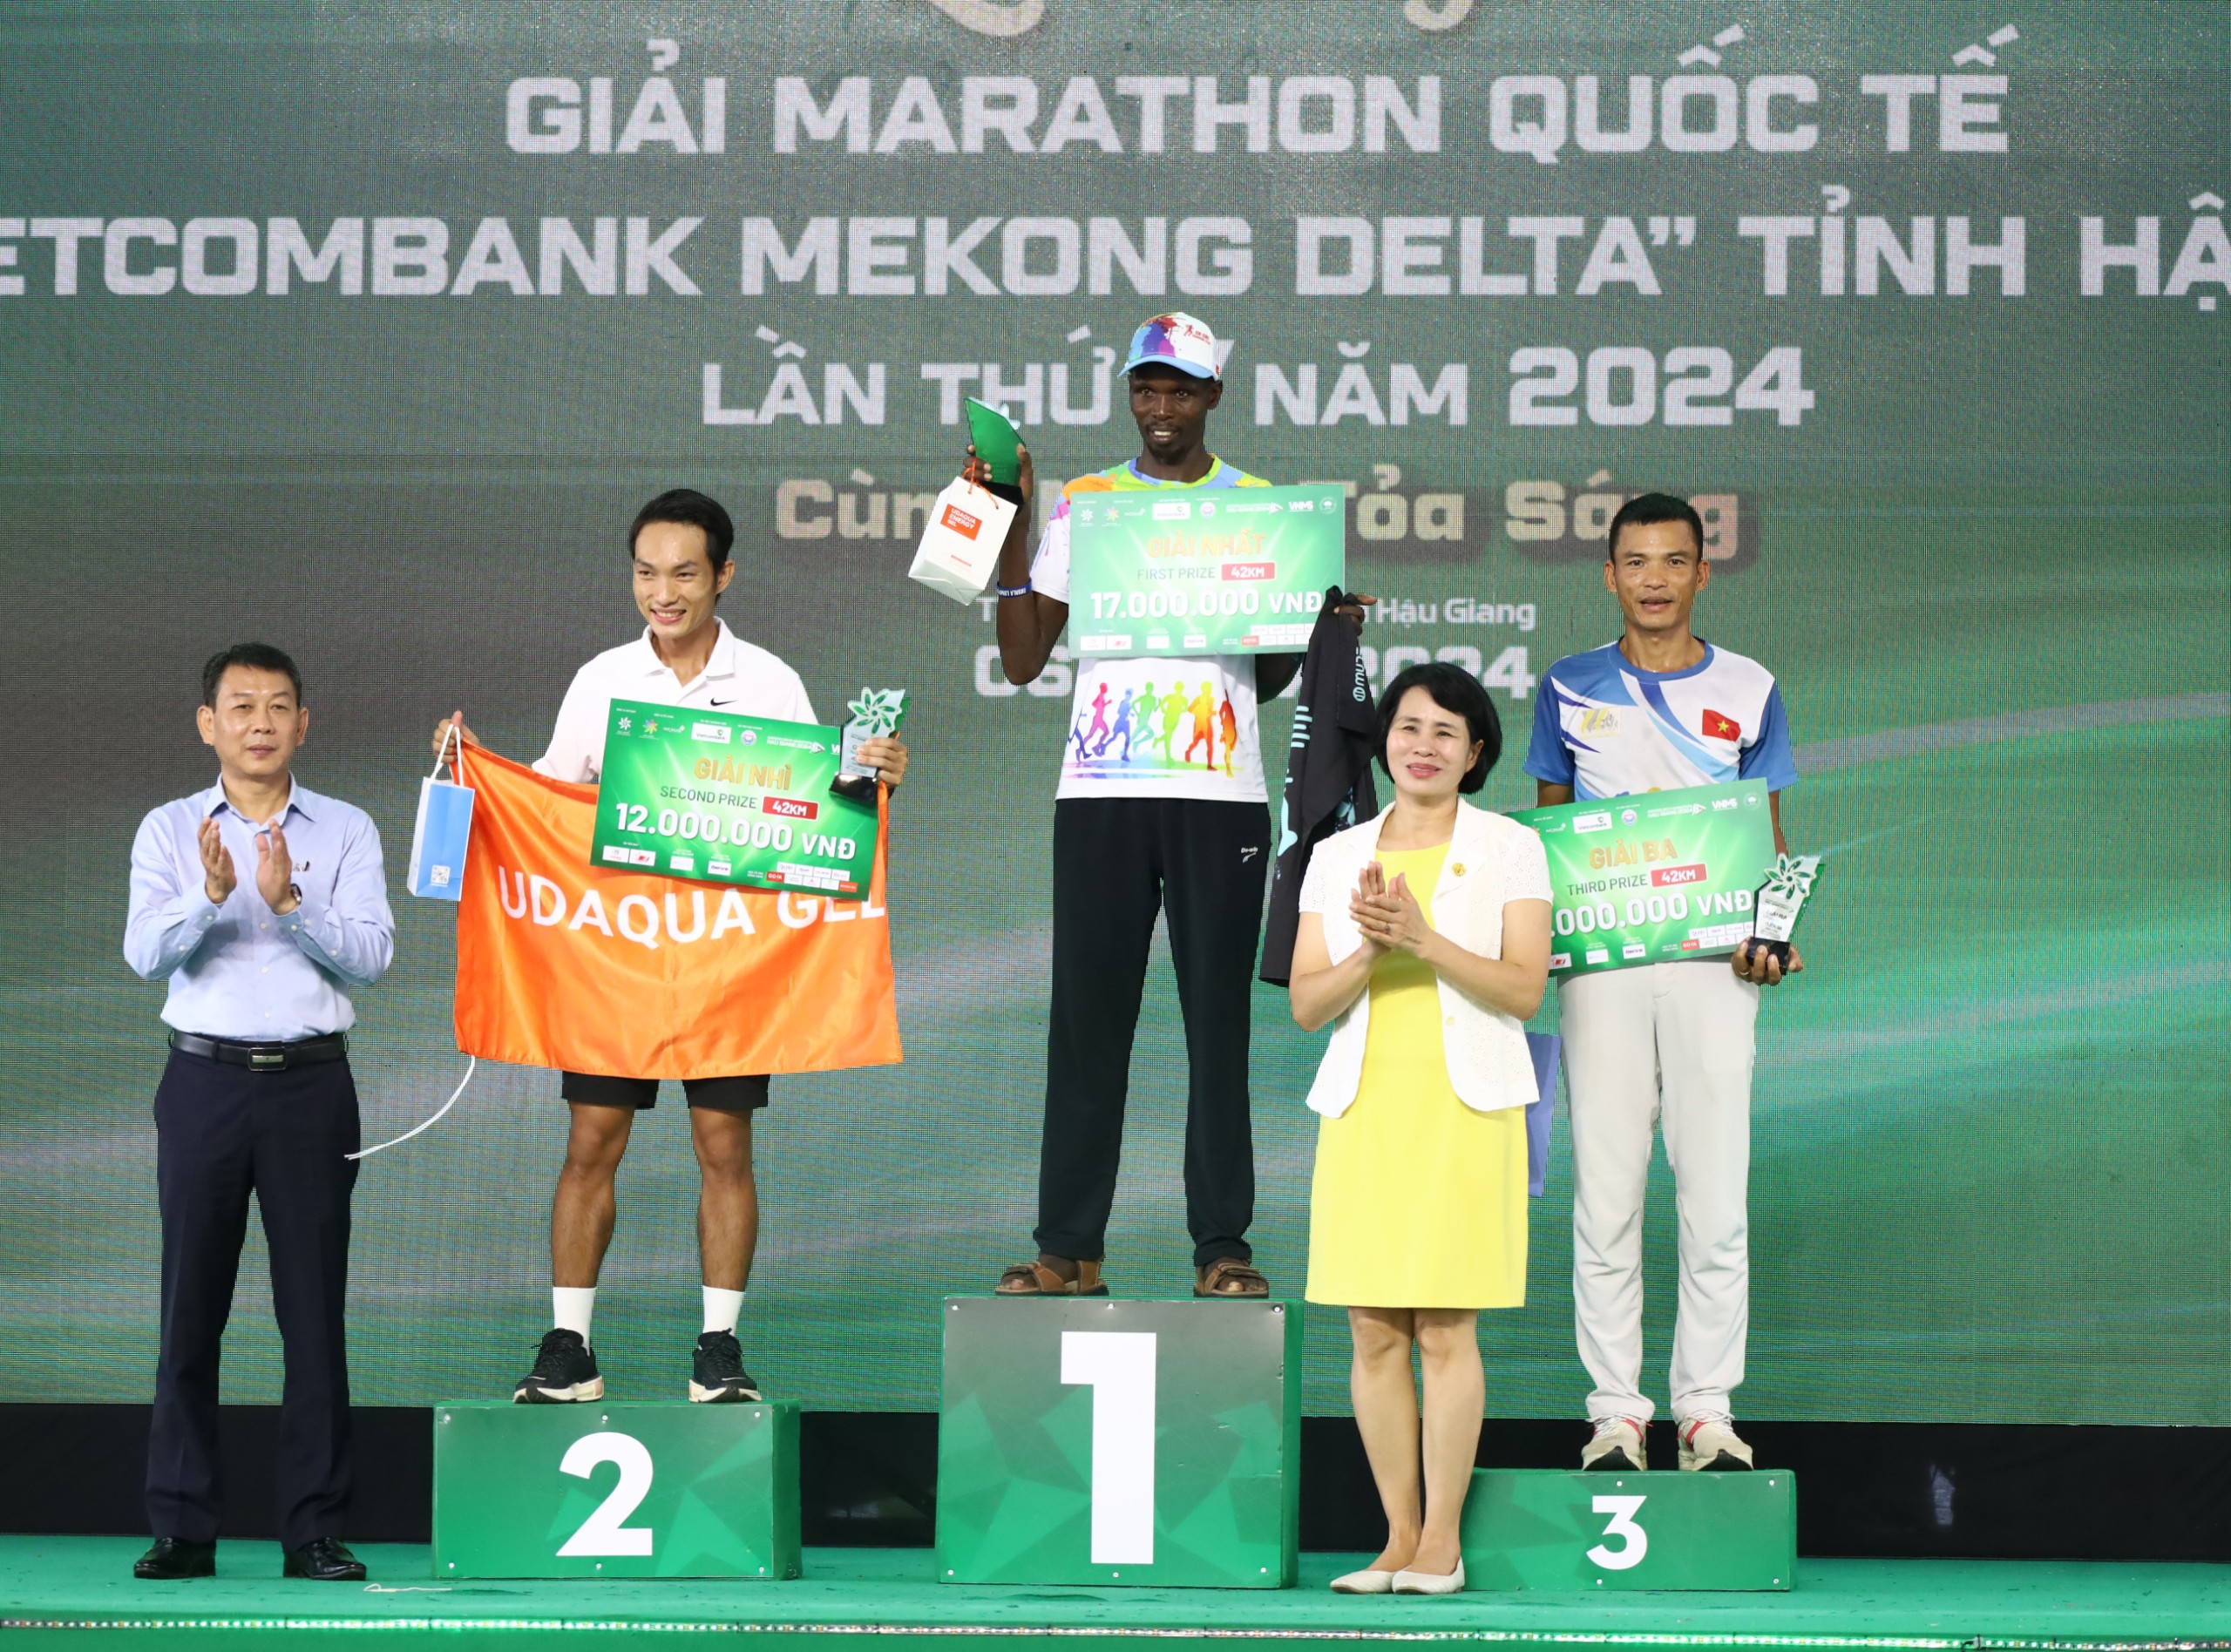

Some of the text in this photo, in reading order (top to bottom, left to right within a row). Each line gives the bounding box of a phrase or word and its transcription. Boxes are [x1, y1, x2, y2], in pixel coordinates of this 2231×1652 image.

[505, 24, 2018, 164] GIẢI MARATHON QUỐC TẾ
[740, 216, 1255, 296] MEKONG
[1738, 185, 2027, 296] TỈNH
[702, 325, 1815, 427] LẦN THỨ NĂM 2024
[776, 467, 939, 540] Cùn
[1504, 469, 1739, 561] Ság
[948, 514, 975, 530] ENERGY
[1147, 526, 1267, 559] GIẢI NHẤT
[1136, 565, 1265, 581] FIRST PRIZE 42KM
[1089, 587, 1324, 620] 17.000.000 VNĐ
[1376, 599, 1535, 632] Hậu Giang
[694, 754, 793, 790] GIẢI NHÌ
[660, 785, 808, 817] SECOND PRIZE 42KM
[615, 802, 857, 861] 12.000.000 VNĐ
[1589, 837, 1678, 870] GIẢI BA
[498, 865, 756, 950] UDAQUA
[1567, 869, 1697, 897] THIRD PRIZE 42KM
[1551, 889, 1753, 938] .000.000 VNĐ
[1060, 1331, 1157, 1566] 1
[555, 1431, 654, 1557] 2
[1585, 1494, 1649, 1571] 3
